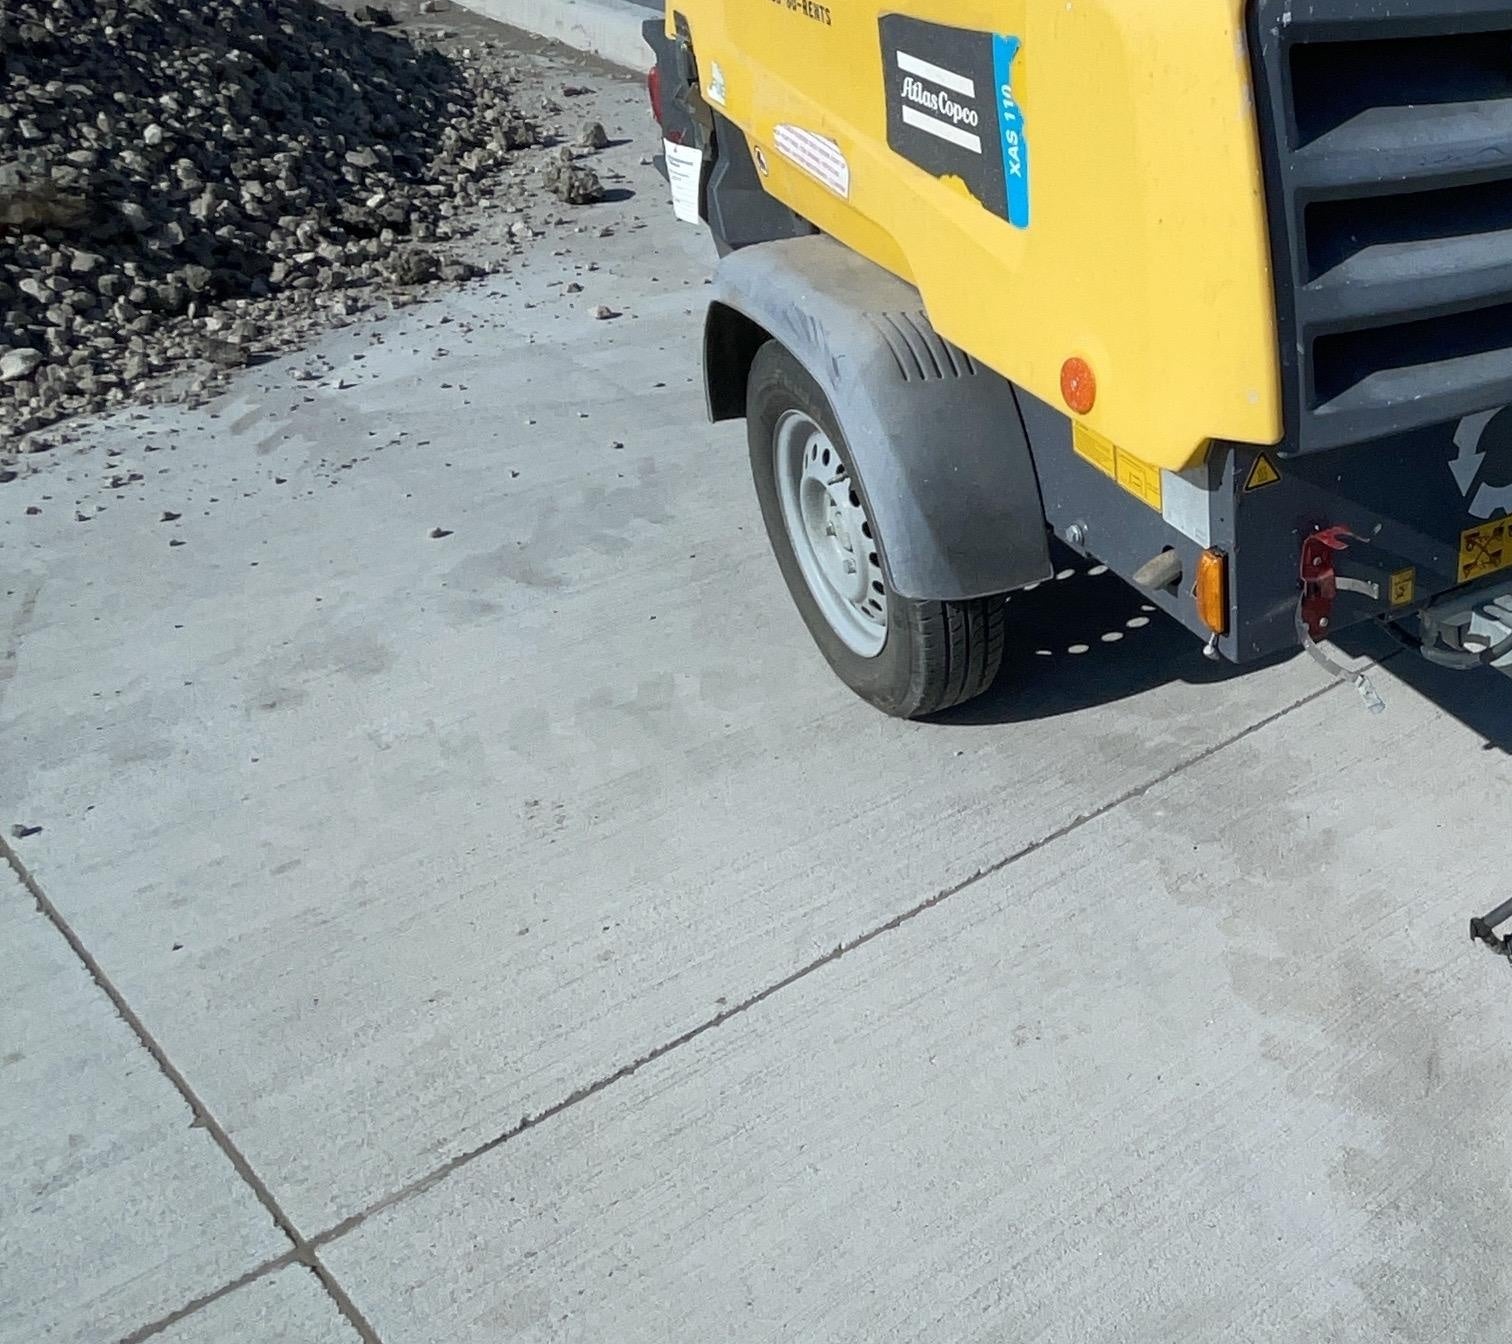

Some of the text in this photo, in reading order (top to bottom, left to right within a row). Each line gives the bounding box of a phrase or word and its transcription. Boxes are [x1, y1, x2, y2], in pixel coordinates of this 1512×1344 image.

[901, 76, 979, 127] Atlas Copco
[1006, 129, 1022, 178] XAS
